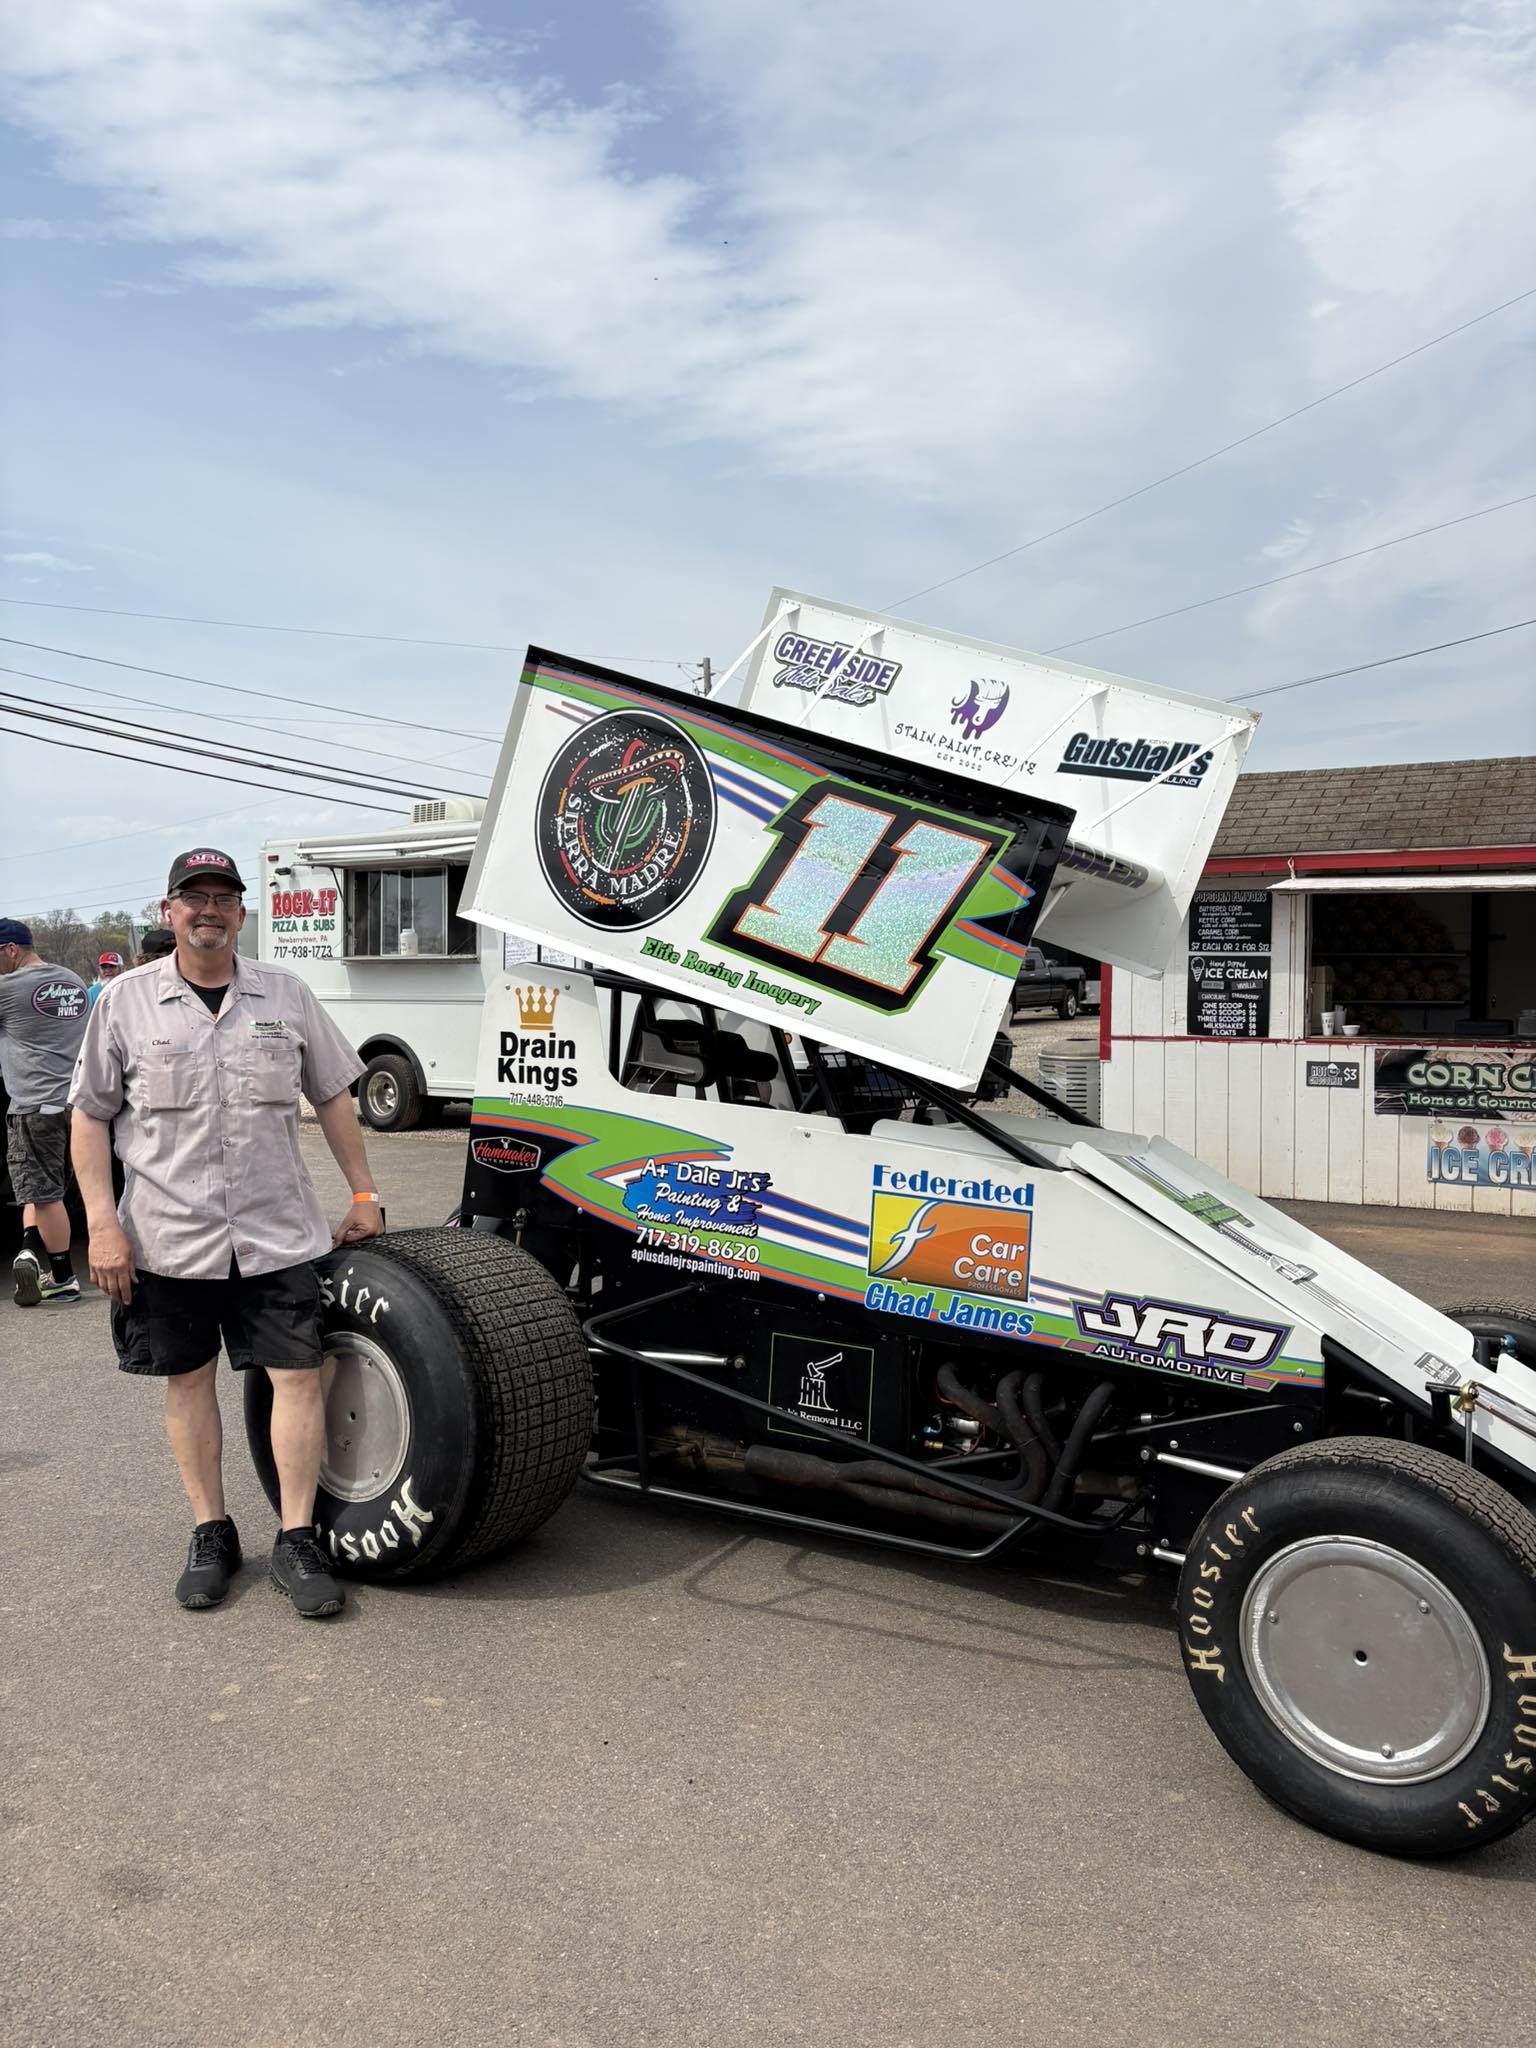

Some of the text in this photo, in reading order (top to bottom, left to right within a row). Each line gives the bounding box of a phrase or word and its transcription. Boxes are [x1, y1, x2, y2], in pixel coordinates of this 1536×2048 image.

[775, 663, 819, 687] Auto
[894, 723, 1038, 776] STAIN.PAINT.CRETE
[959, 759, 983, 772] 2022
[1063, 732, 1215, 776] Gutshall's
[1151, 774, 1199, 786] ULING
[563, 793, 599, 890] SIERRA
[609, 831, 682, 896] MADRE
[272, 888, 337, 919] ROCK-IT
[733, 793, 993, 995] 11
[1193, 890, 1267, 903] POPCORN FLAVORS
[272, 919, 335, 933] PIZZA & SUBS
[1202, 942, 1221, 951] EACH
[1223, 942, 1233, 951] OR
[1235, 943, 1240, 951] 2
[1242, 943, 1256, 952] FOR
[1258, 942, 1270, 952] $12
[640, 936, 823, 1016] Elite Racing Imagery
[1205, 968, 1268, 980] ICE CREAM
[57, 1006, 79, 1017] HVAC
[500, 1031, 576, 1059] Drain
[497, 1057, 578, 1092] Kings
[1343, 1067, 1358, 1082] $3
[1407, 1062, 1536, 1090] CORN C
[509, 1092, 564, 1108] 717-448-3716
[1408, 1092, 1454, 1106] Home
[1457, 1094, 1476, 1106] of
[475, 1142, 537, 1163] Hammaker
[1430, 1145, 1480, 1183] ICE
[642, 1158, 761, 1192] A+ Dale Jr.'s
[873, 1164, 1034, 1207] Federated
[654, 1182, 742, 1216] Painting &
[636, 1203, 759, 1239] Home Improvement
[635, 1225, 760, 1264] 717-319-8620
[969, 1232, 1025, 1262] Car
[631, 1248, 761, 1282] aplusdalejrspainting.com
[952, 1255, 1023, 1288] Care
[319, 1266, 391, 1324] sier
[967, 1281, 1022, 1297] PROFESSIONALS
[864, 1281, 1035, 1337] Chad James
[1095, 1344, 1245, 1384] AUTOMOTIVE
[800, 1410, 838, 1427] Removal
[841, 1418, 863, 1431] LLC
[315, 1474, 434, 1562] Hoosi
[1188, 1506, 1261, 1684] Hoosier
